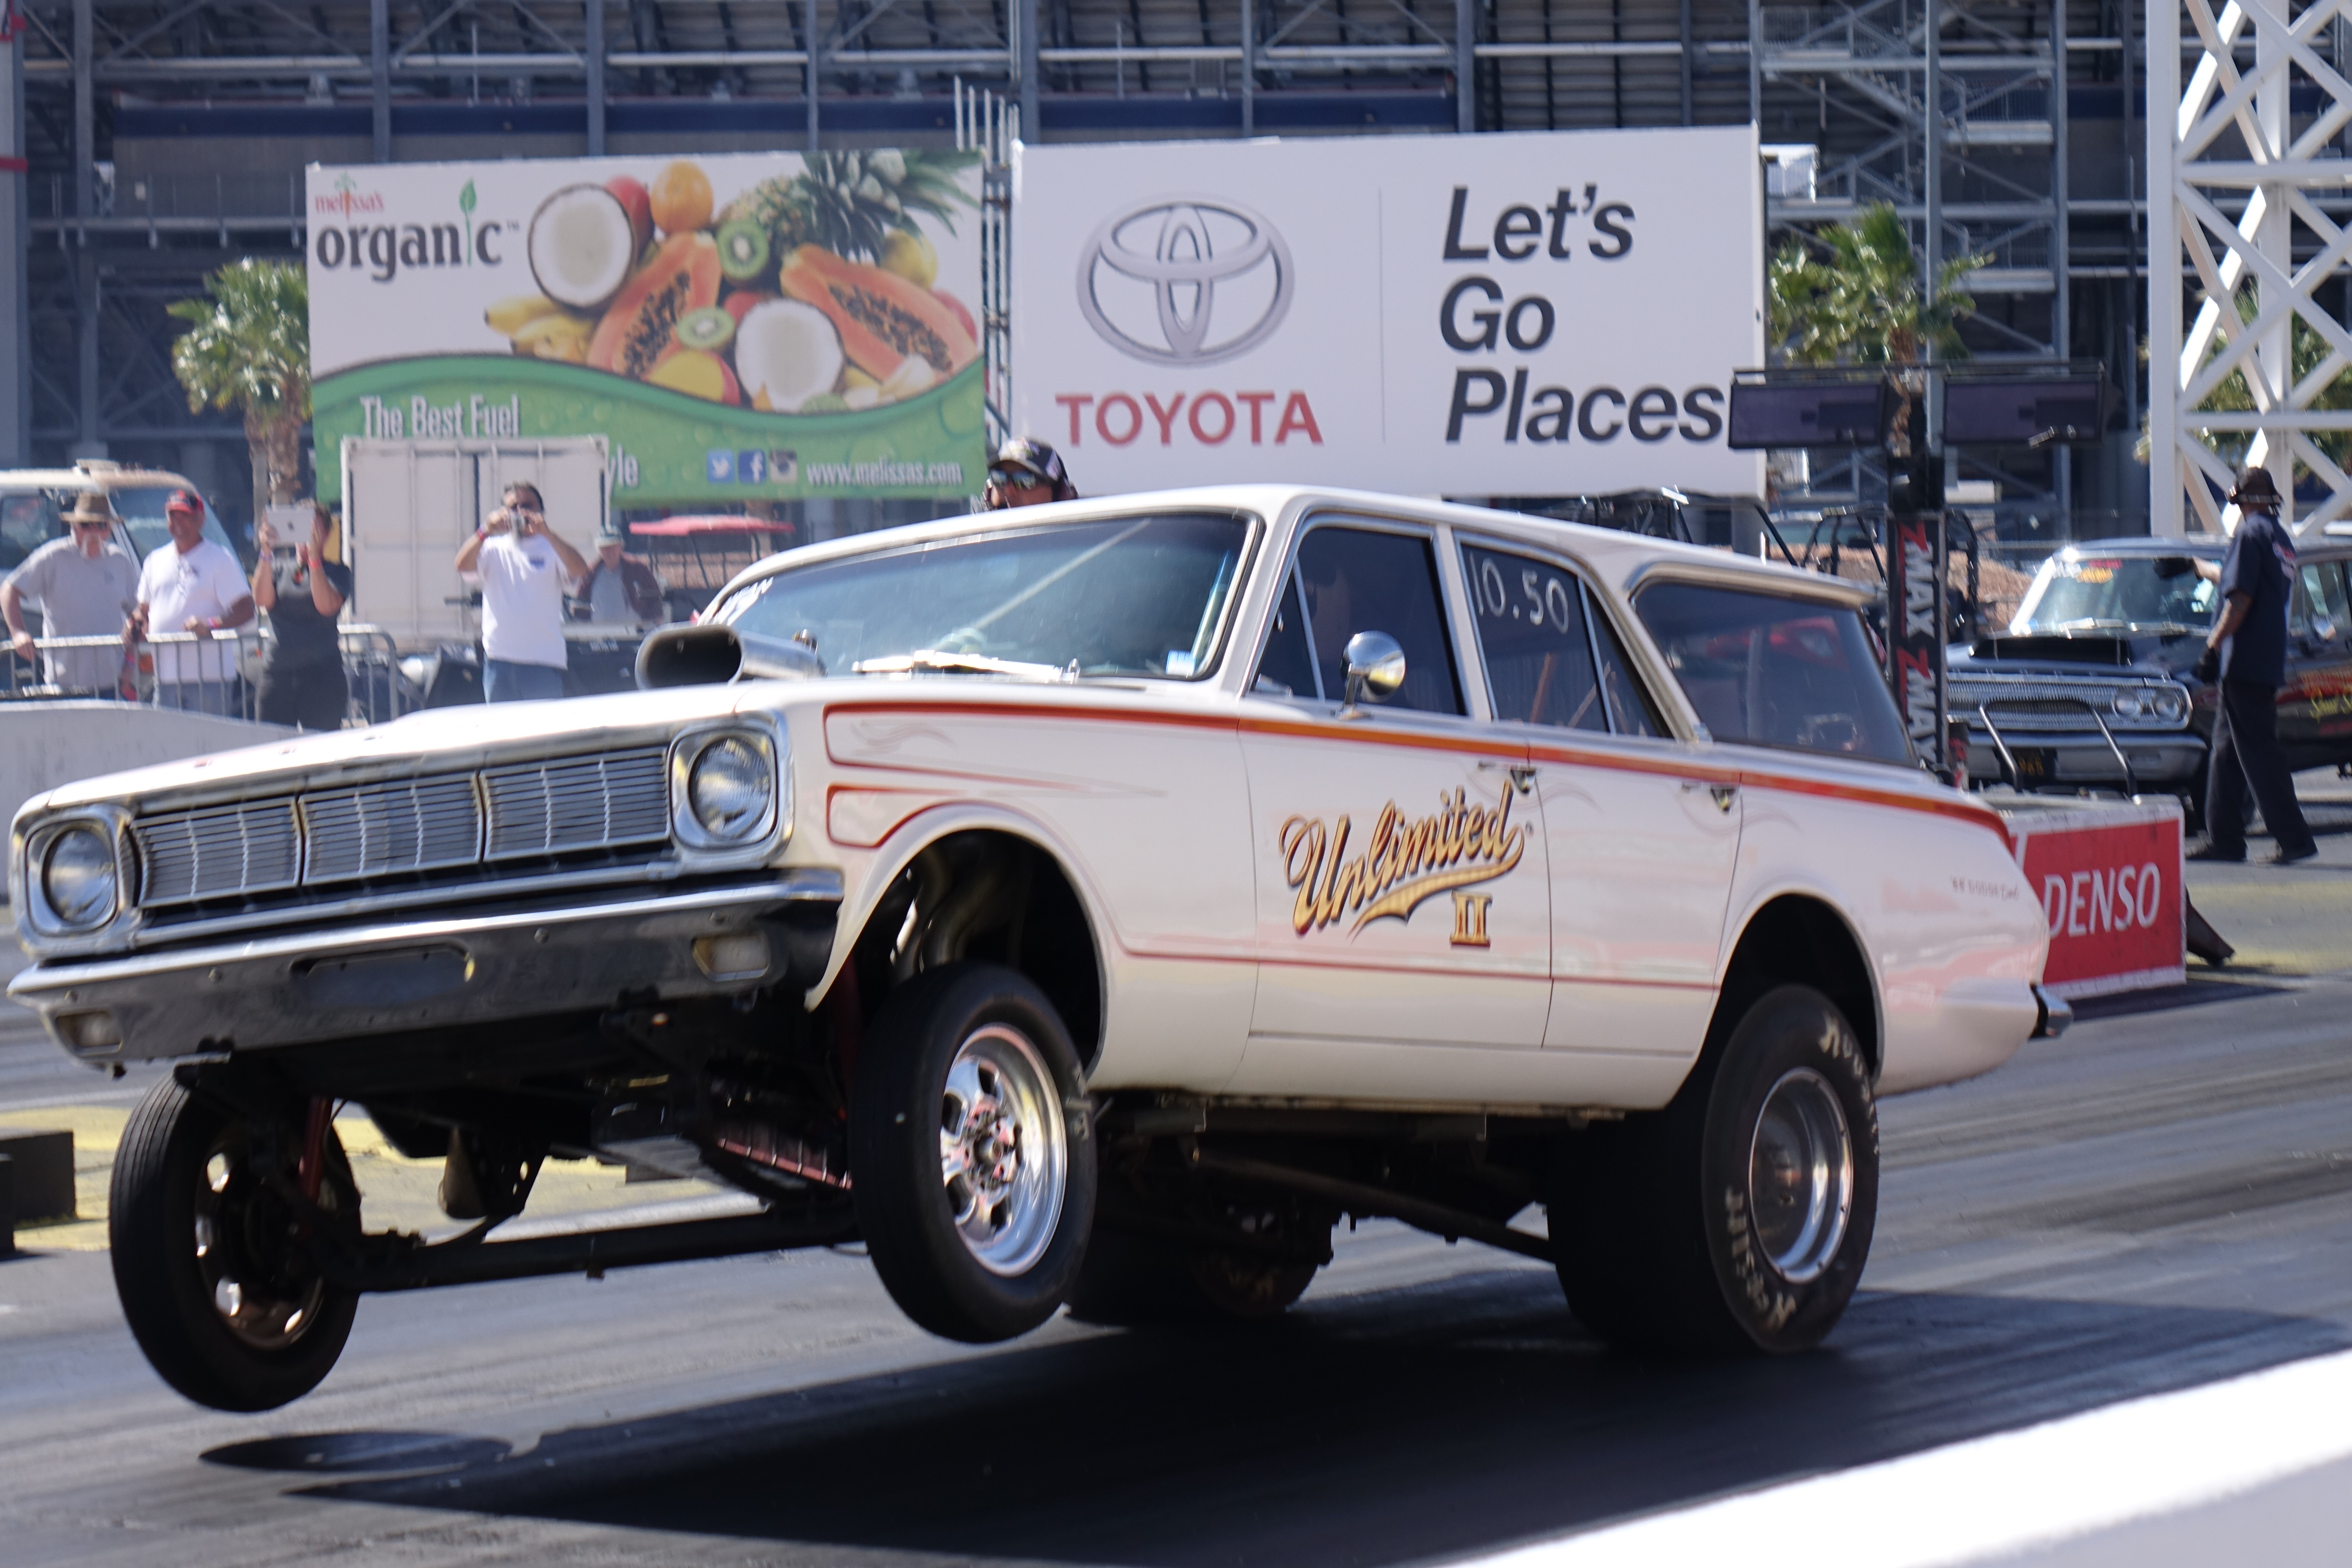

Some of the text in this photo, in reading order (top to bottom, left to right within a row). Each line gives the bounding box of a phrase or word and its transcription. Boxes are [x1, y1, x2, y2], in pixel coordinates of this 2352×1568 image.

[316, 200, 502, 283] organic
[1441, 182, 1636, 263] Let's
[1439, 273, 1556, 354] Go
[360, 393, 520, 440] The Best Fuel
[1055, 389, 1324, 447] TOYOTA
[1445, 366, 1726, 445] Places
[1469, 549, 1570, 634] 10.50
[1278, 779, 1525, 940] Unlimited
[2043, 861, 2161, 940] DENSO
